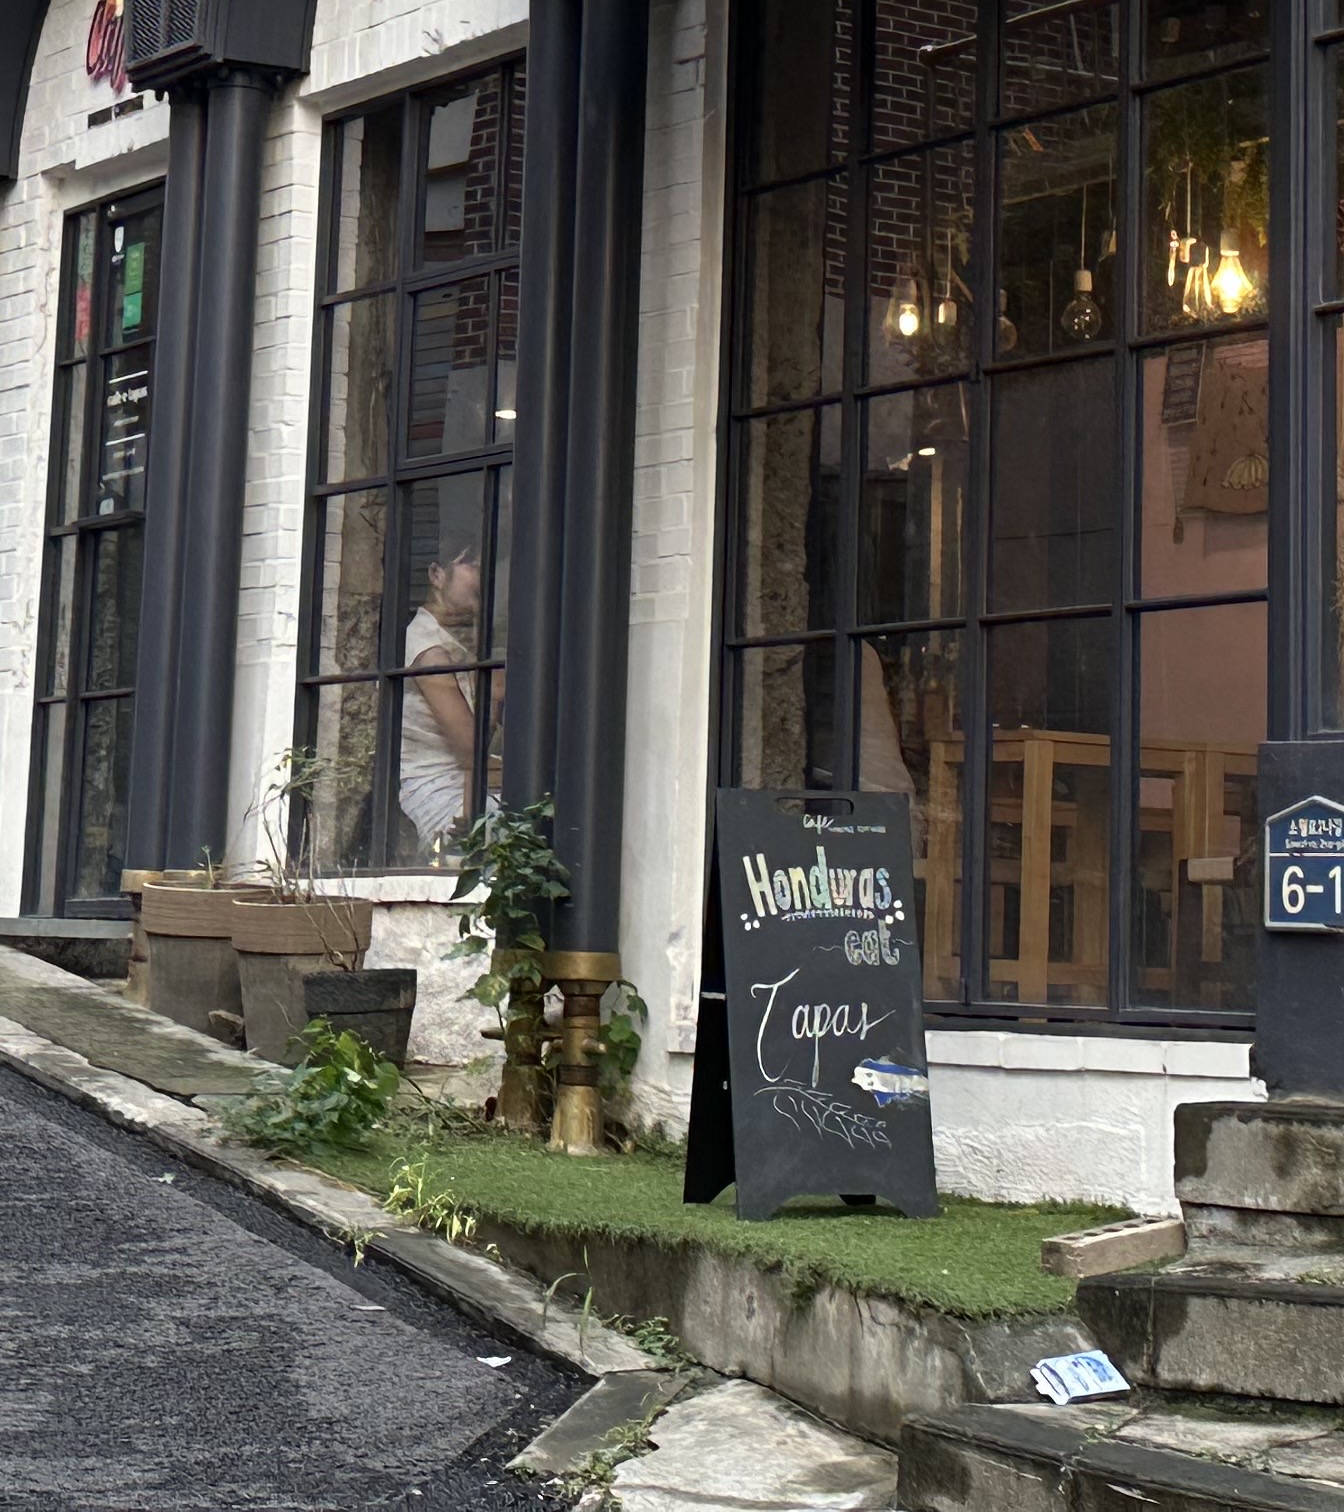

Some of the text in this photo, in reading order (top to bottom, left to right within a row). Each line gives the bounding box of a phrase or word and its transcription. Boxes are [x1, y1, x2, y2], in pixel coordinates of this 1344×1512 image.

[742, 846, 893, 917] Honduras
[1282, 865, 1343, 914] 6-1
[844, 919, 900, 965] eat
